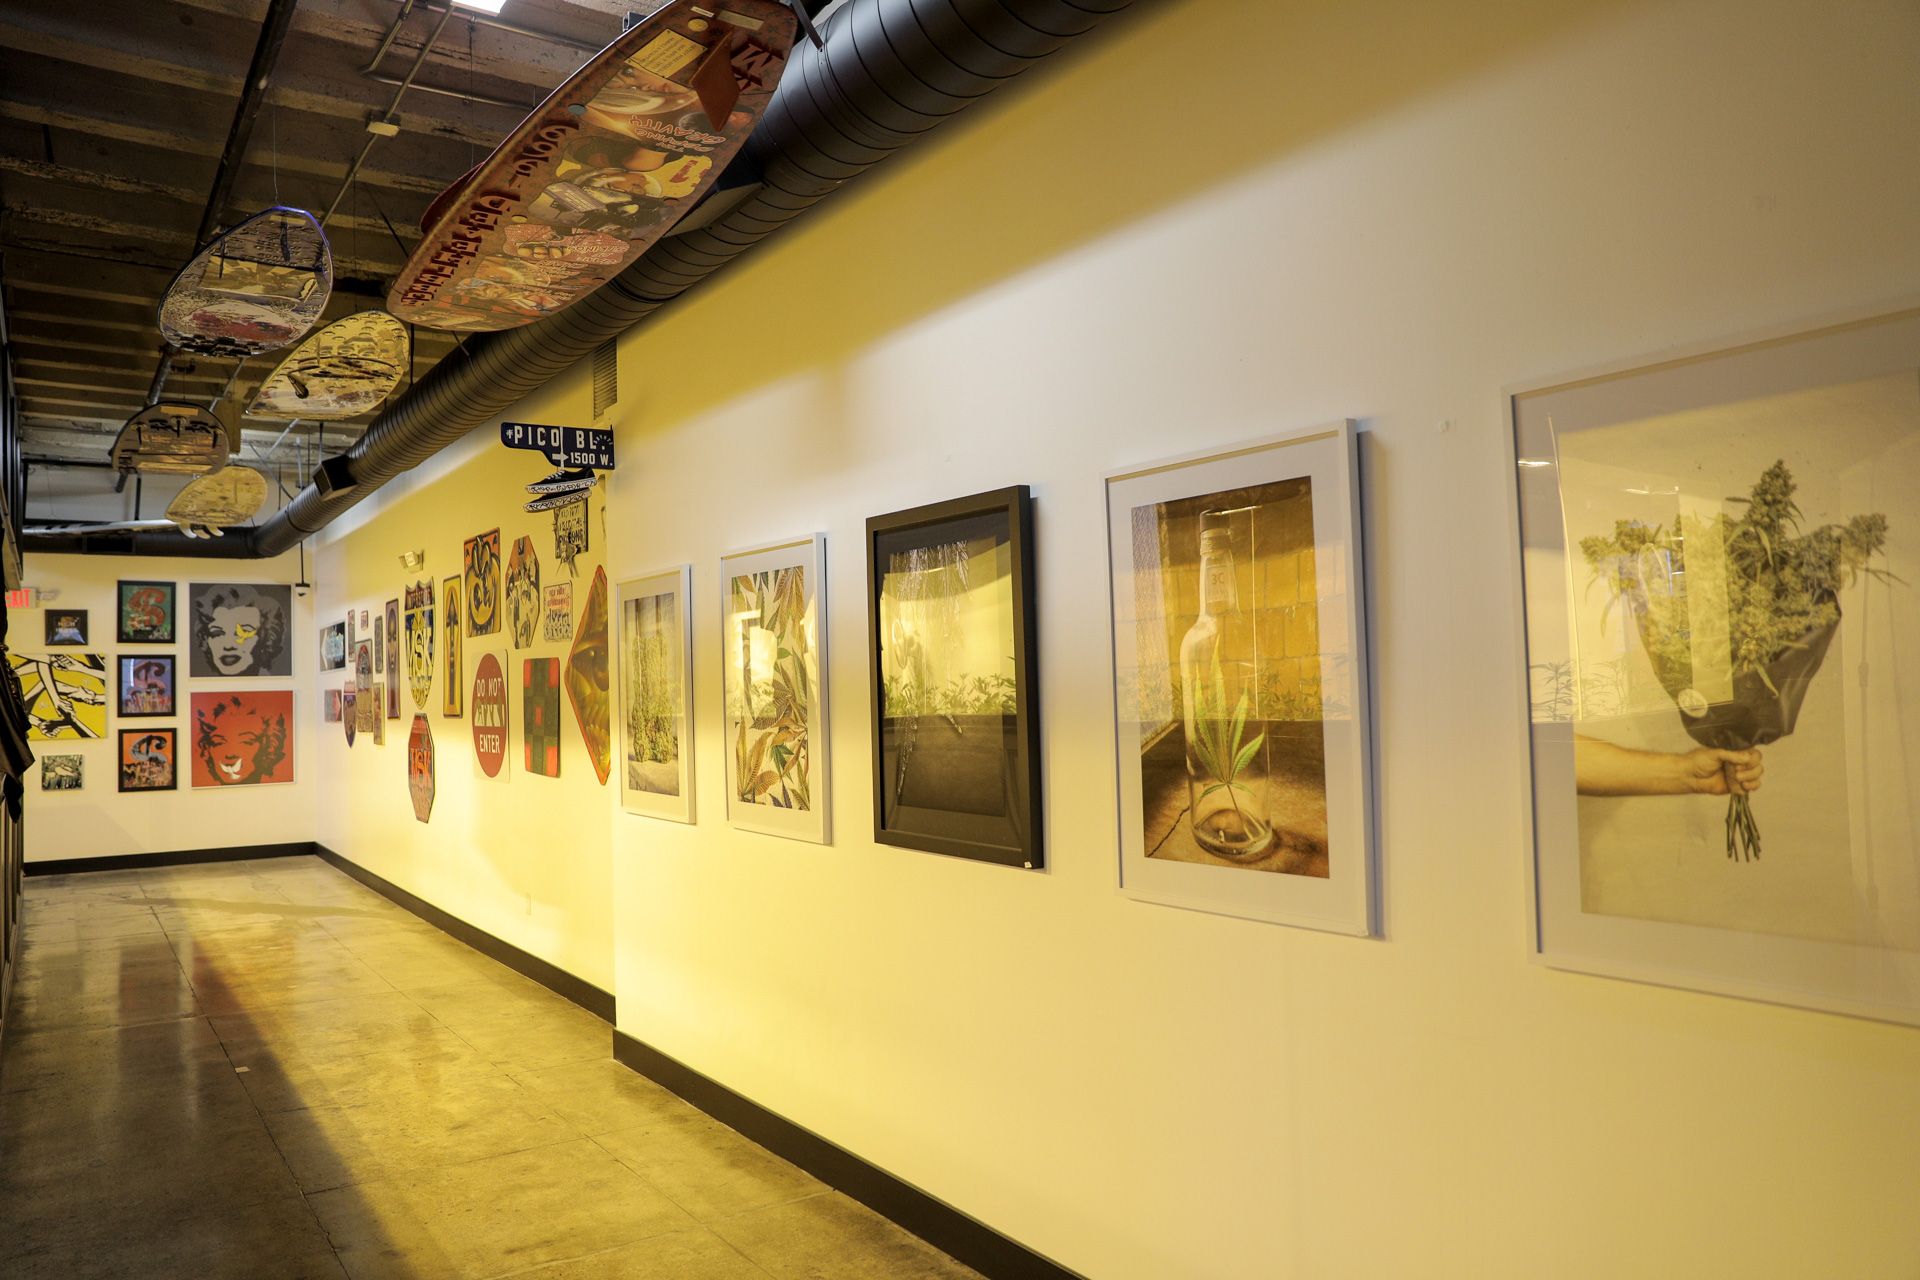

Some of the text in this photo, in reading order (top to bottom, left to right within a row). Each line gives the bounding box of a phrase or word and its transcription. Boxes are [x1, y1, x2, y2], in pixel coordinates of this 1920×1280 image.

[629, 115, 727, 145] GRAVITY
[514, 425, 560, 447] PICO
[570, 452, 596, 465] 1500
[476, 678, 502, 696] DO NOT
[479, 734, 500, 754] ENTER
